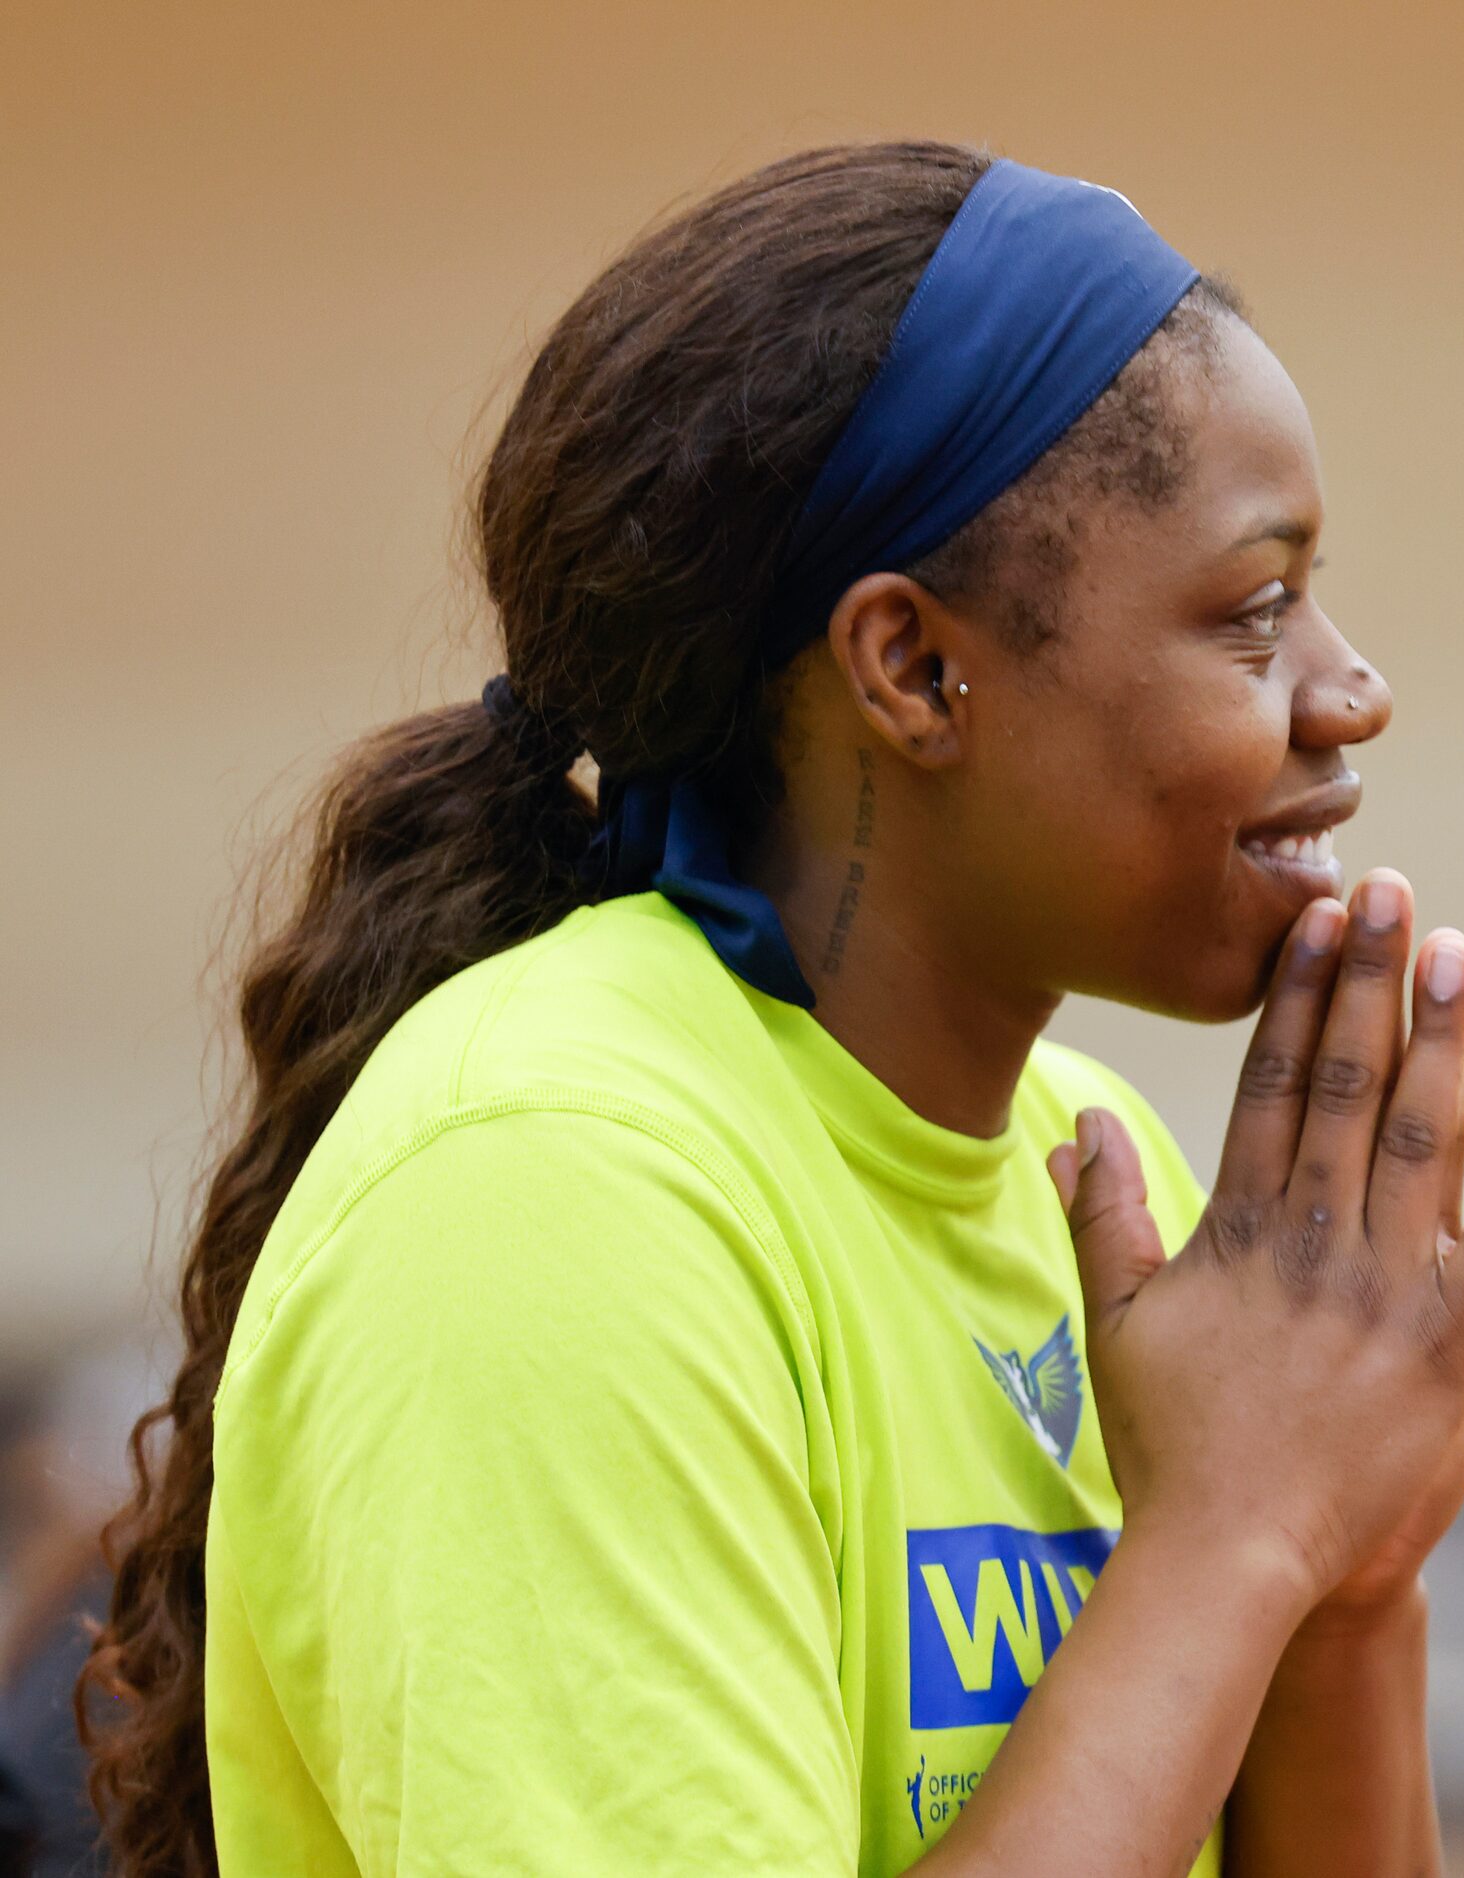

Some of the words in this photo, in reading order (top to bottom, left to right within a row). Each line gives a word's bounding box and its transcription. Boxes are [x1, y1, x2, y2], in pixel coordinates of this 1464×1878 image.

[920, 1558, 1097, 1692] WI
[929, 1771, 983, 1797] OFFIC
[930, 1801, 950, 1823] OF
